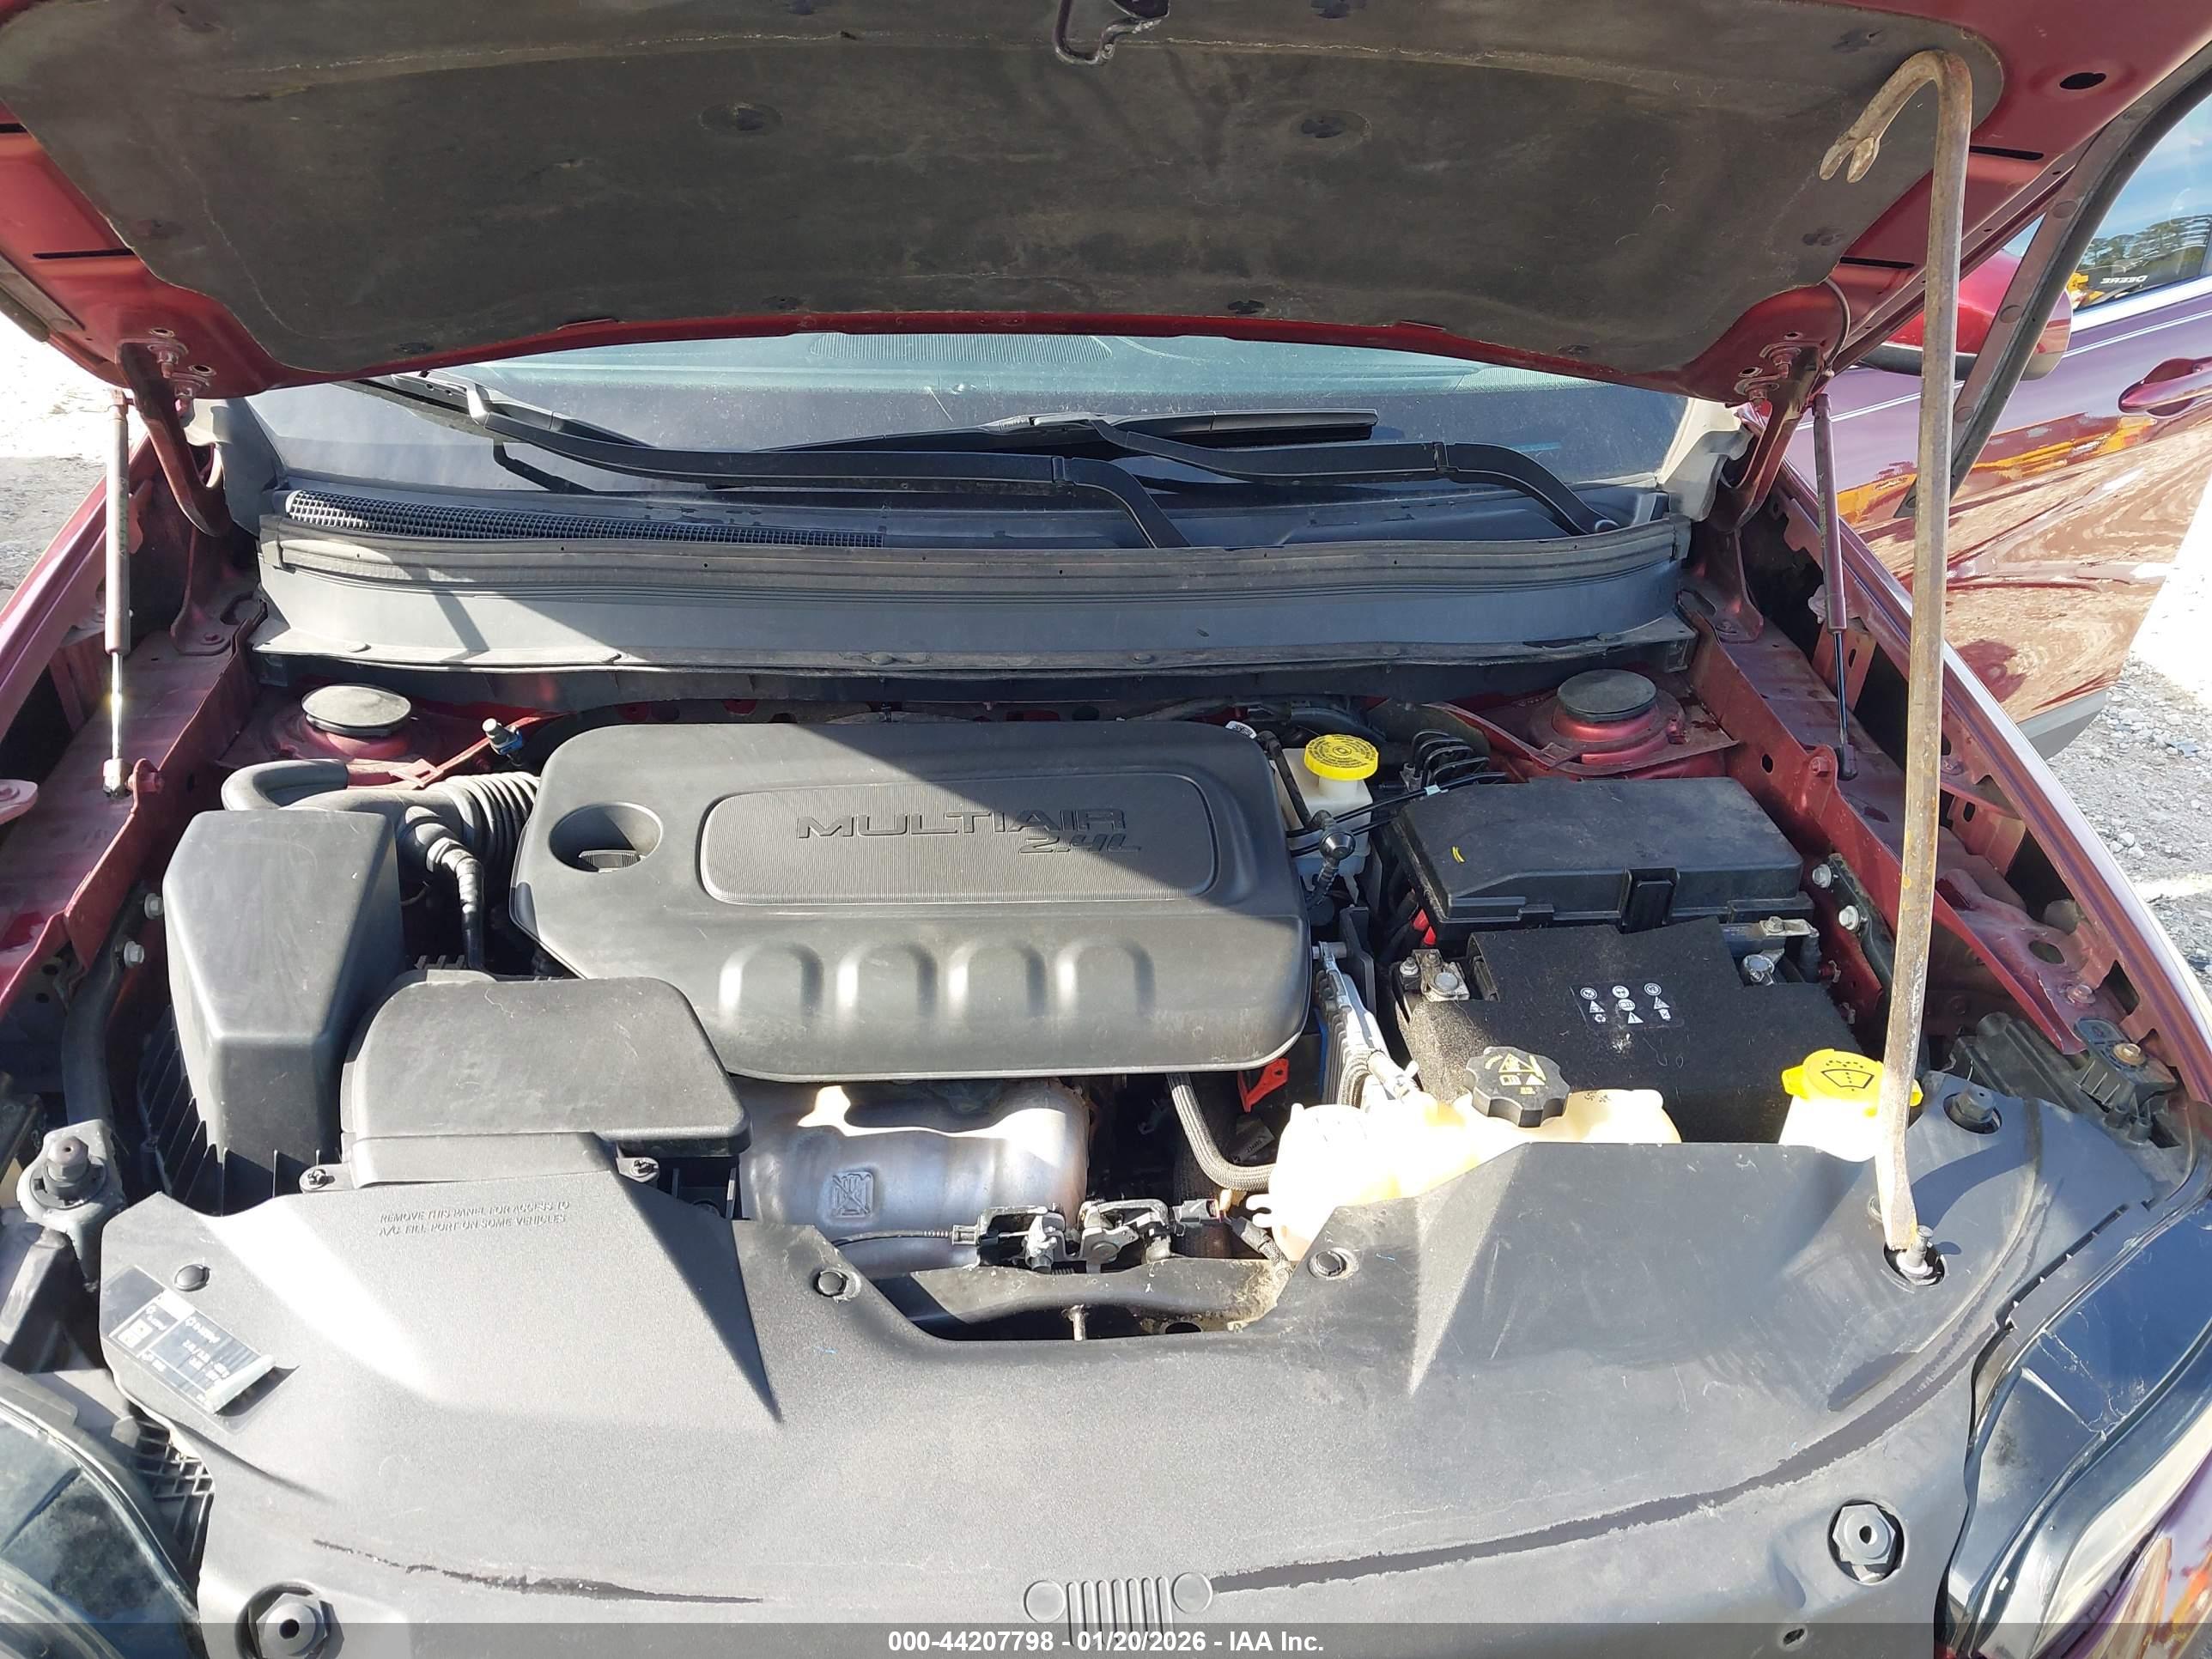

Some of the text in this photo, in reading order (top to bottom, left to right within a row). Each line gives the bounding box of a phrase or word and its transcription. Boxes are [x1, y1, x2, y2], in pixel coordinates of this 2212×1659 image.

[798, 809, 1127, 839] MULTIAIR
[1018, 834, 1142, 854] 2.4L
[380, 1200, 570, 1224] REMOVE THIS PANEL FOR ACCESS TO
[379, 1214, 567, 1237] A/C FILL PORT ON SOME VEHICLES
